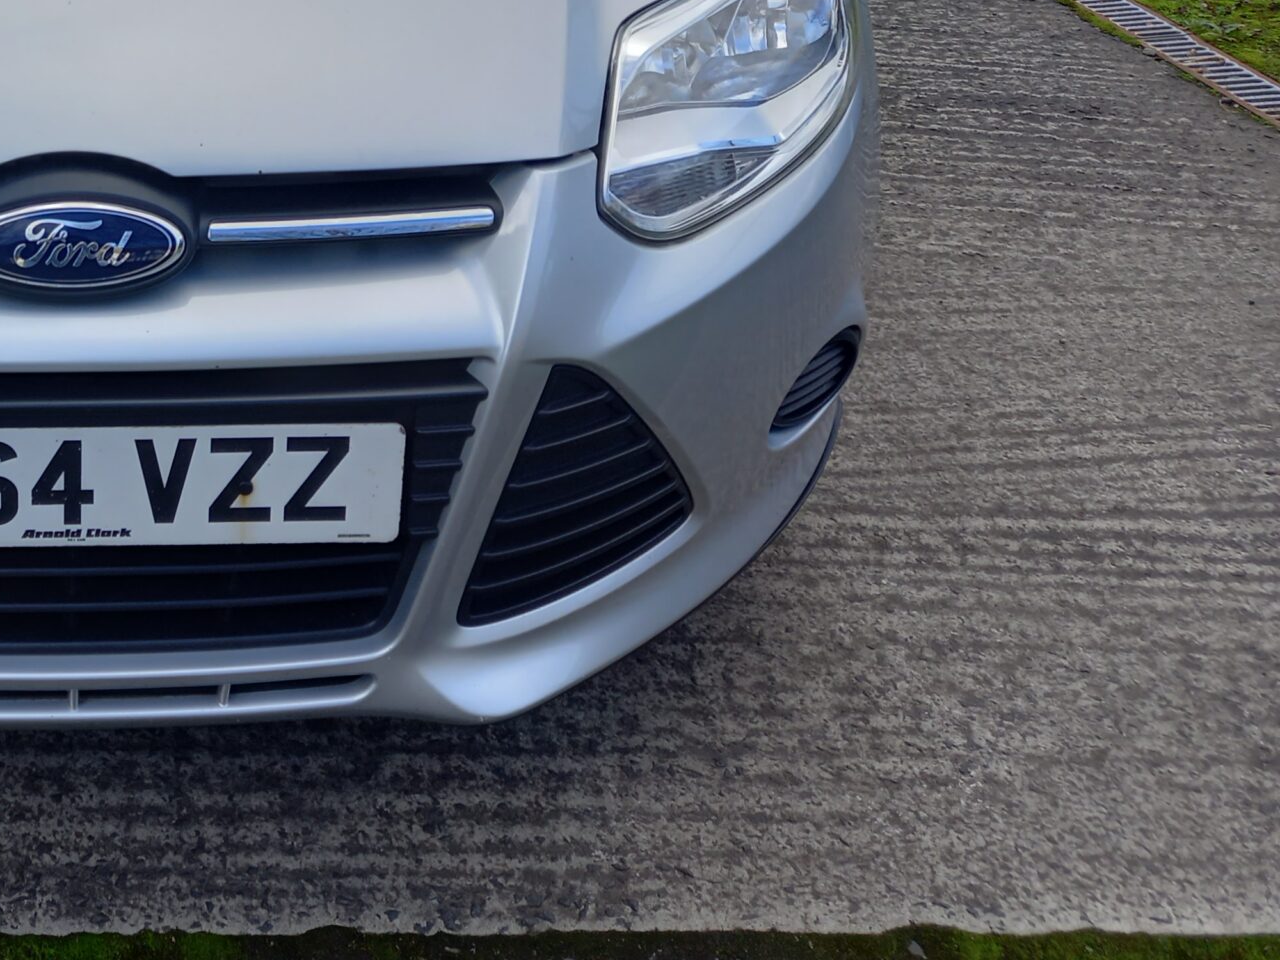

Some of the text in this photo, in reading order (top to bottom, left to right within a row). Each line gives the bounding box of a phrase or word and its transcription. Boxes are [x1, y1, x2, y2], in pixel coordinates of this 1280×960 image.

[14, 218, 133, 268] Ford
[134, 436, 351, 524] VZZ
[22, 528, 131, 539] Arnold Clark
